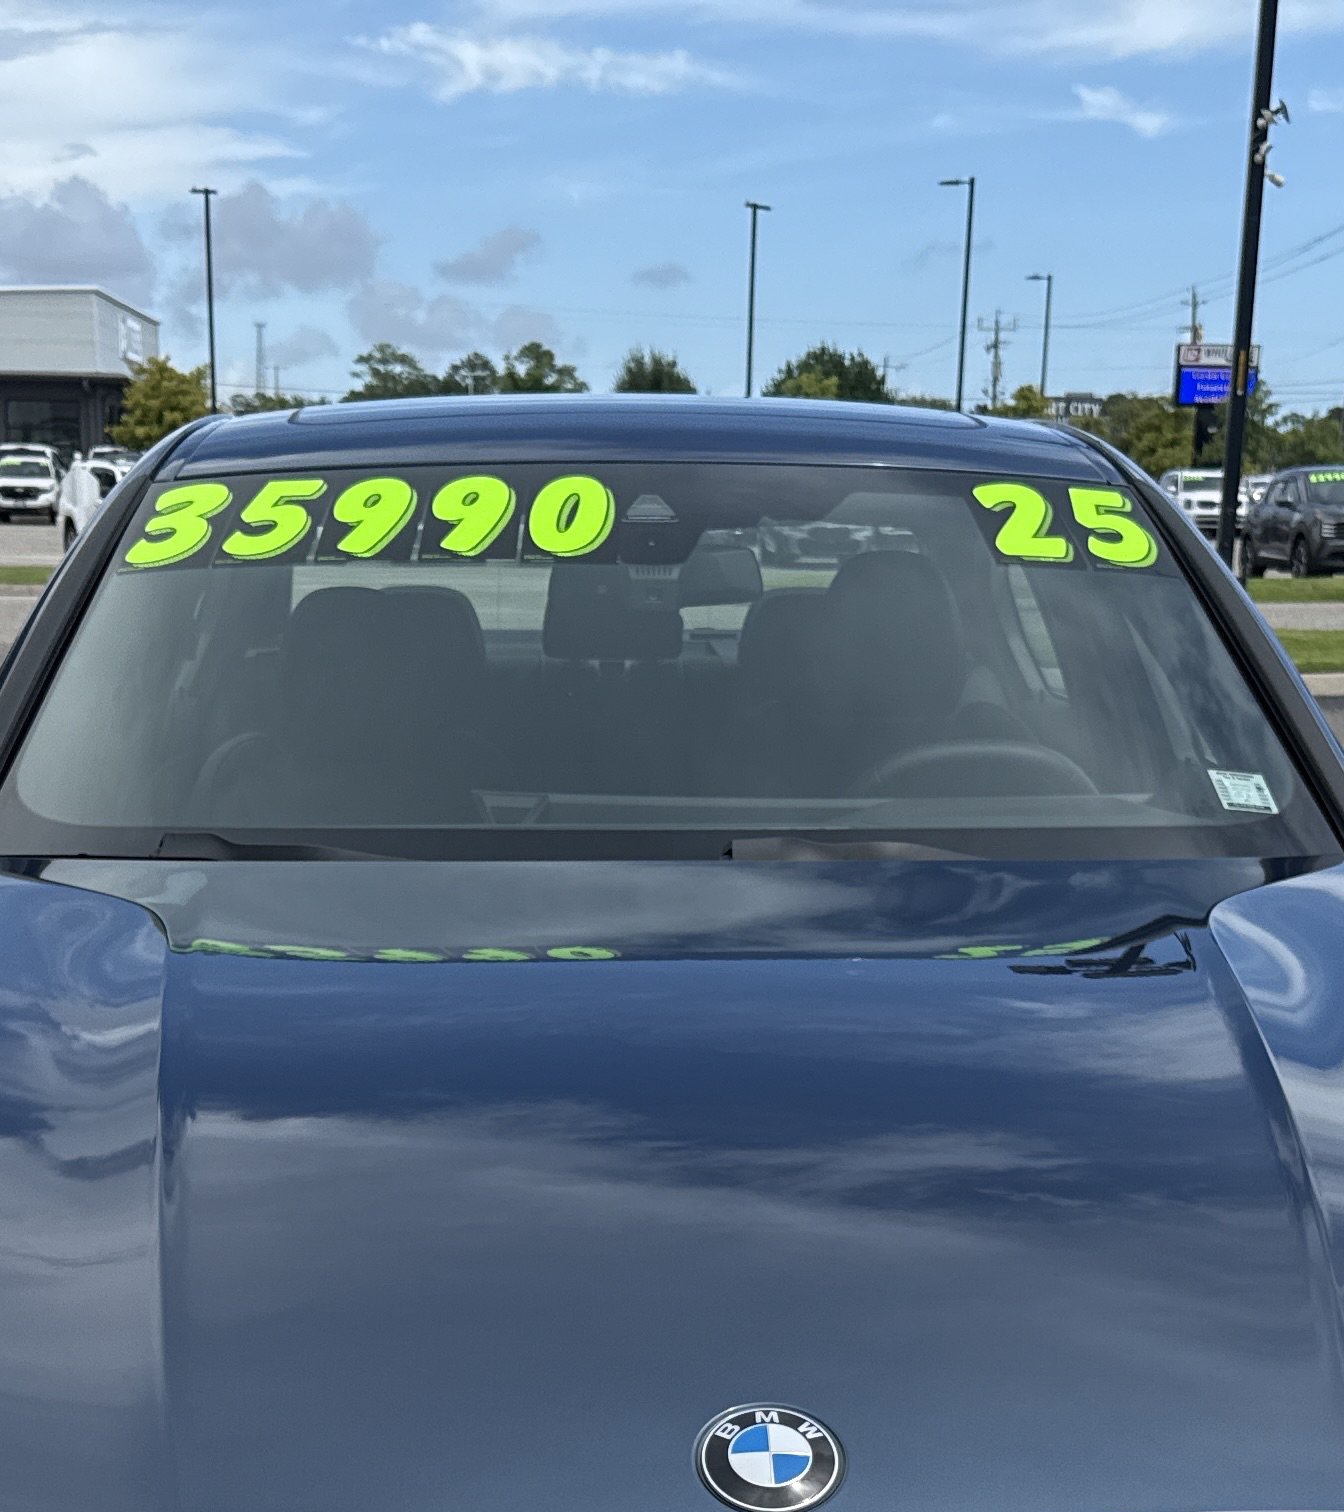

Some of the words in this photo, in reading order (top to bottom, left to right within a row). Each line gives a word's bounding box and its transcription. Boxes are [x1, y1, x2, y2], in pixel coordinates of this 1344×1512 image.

[124, 475, 617, 568] 35990
[972, 483, 1158, 569] 25
[714, 1410, 824, 1440] BMW
